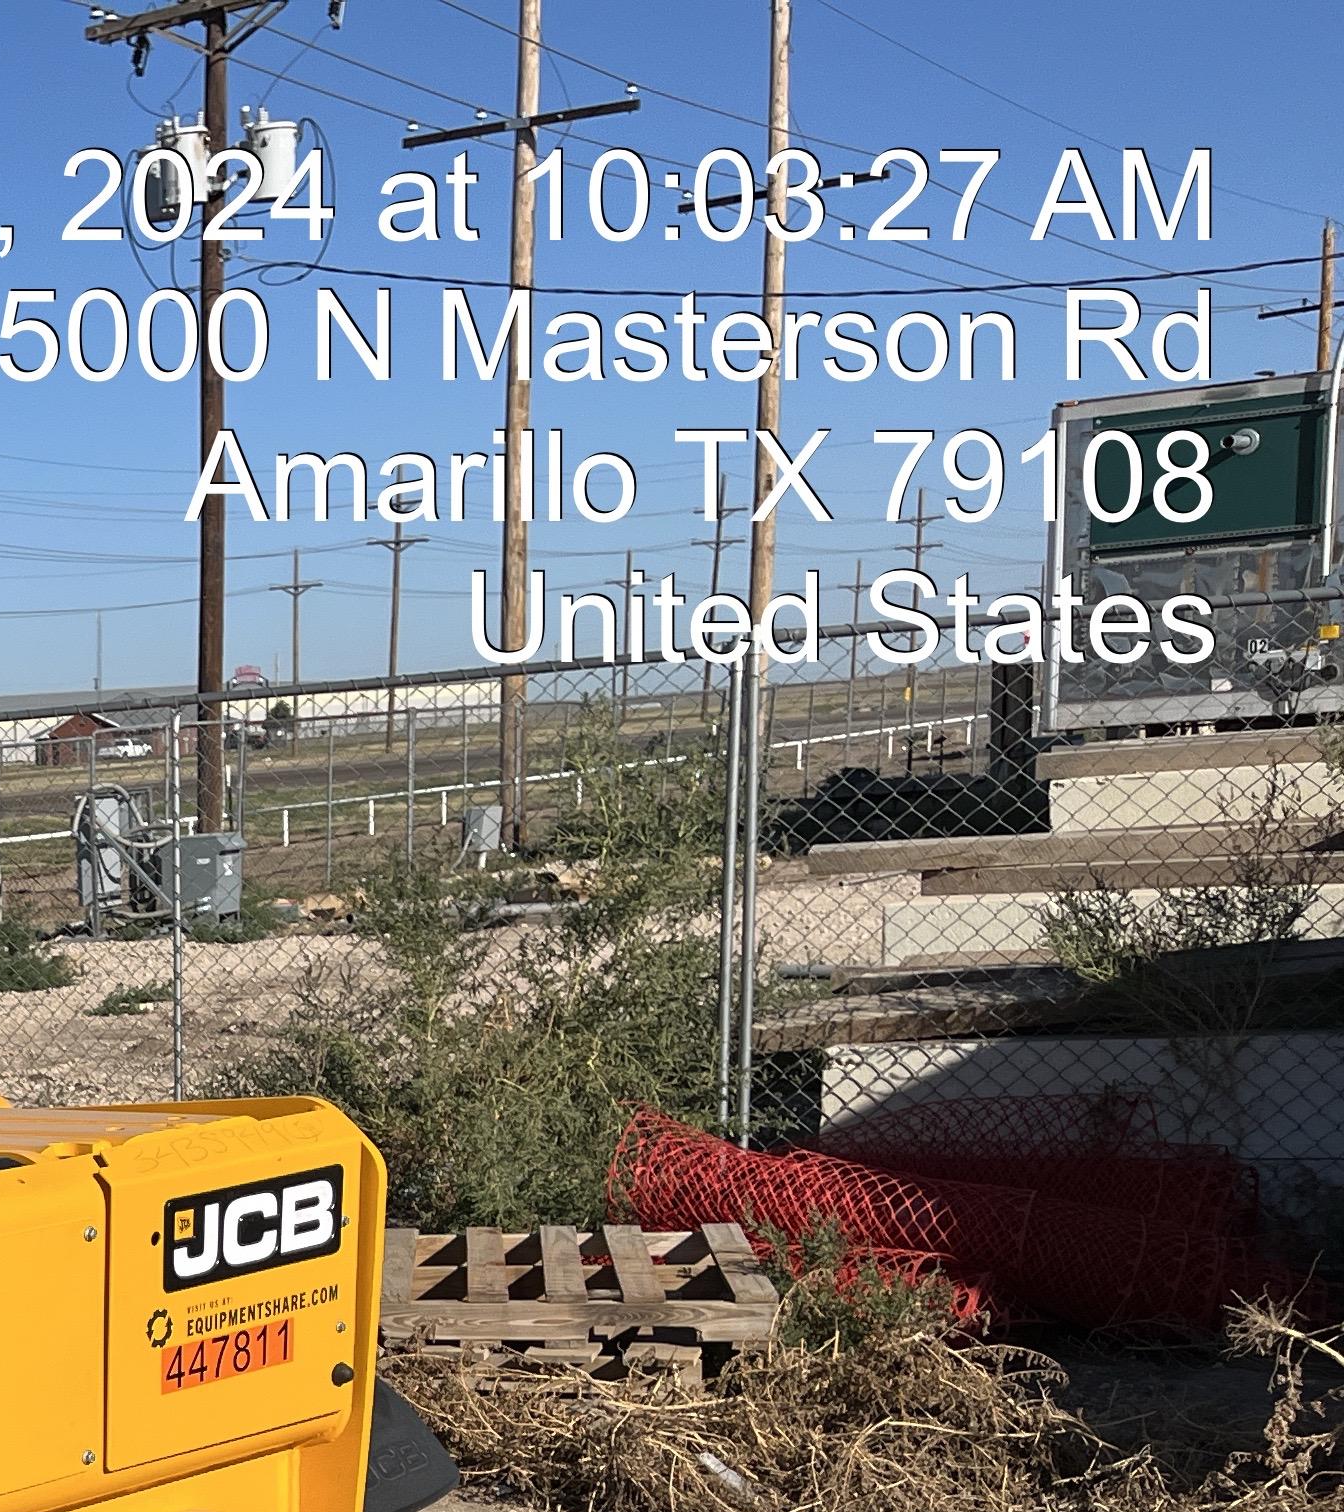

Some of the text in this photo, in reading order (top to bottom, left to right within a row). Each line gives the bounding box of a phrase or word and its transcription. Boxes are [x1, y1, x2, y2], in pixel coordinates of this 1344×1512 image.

[173, 1180, 334, 1279] JCB
[187, 1284, 338, 1336] EQUIPMENTSHARE.COM
[165, 1319, 289, 1388] 447811
